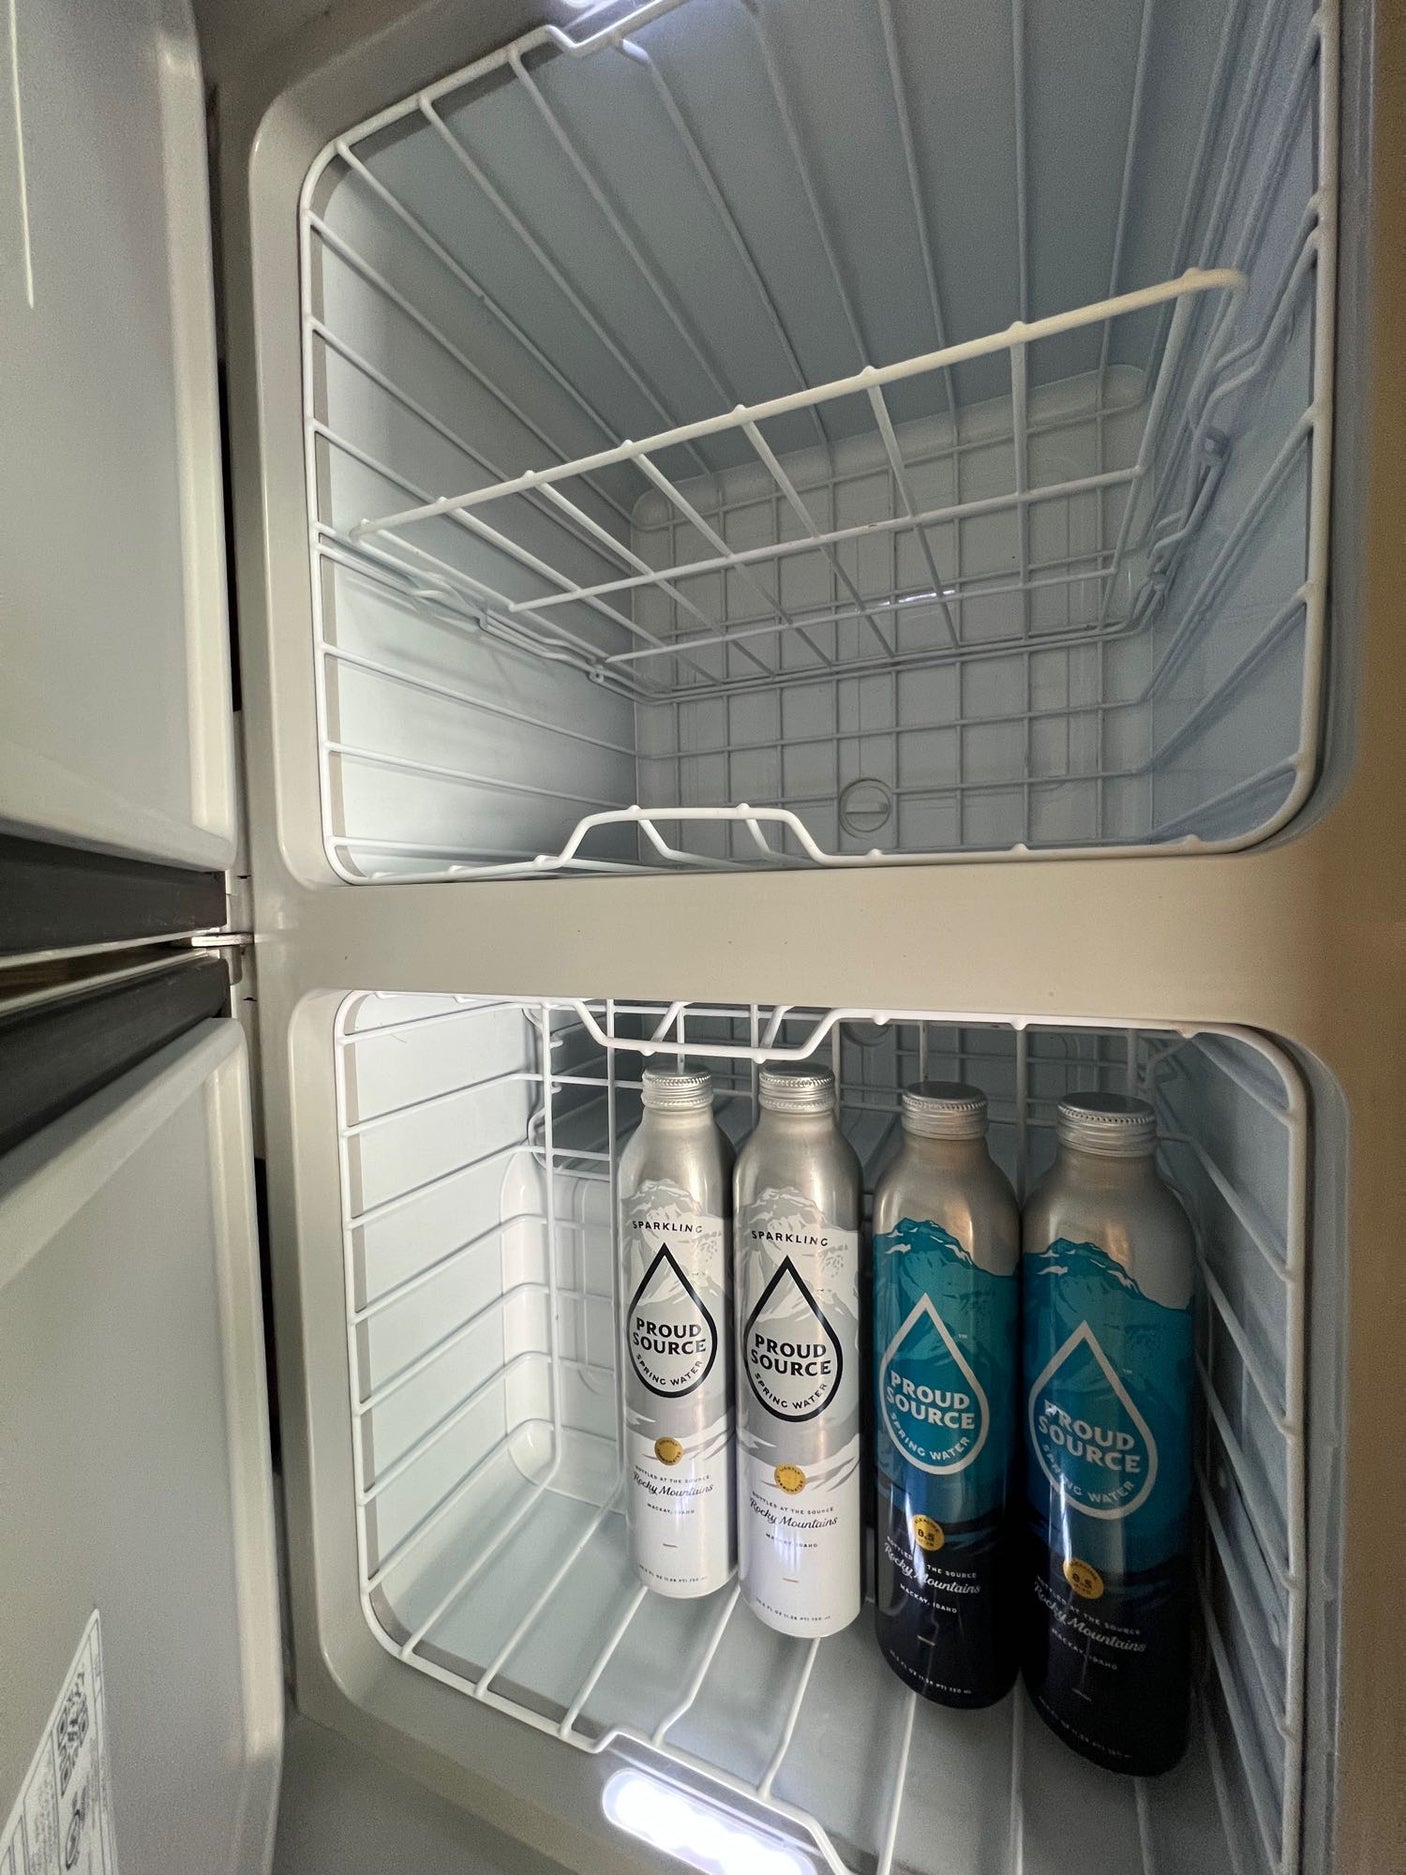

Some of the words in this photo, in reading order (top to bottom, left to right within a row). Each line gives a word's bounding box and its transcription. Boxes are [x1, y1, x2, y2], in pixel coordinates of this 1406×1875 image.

[632, 1220, 703, 1233] SPARKLING
[751, 1230, 829, 1246] SPARKLING
[636, 1317, 702, 1338] PROUD
[633, 1332, 706, 1355] SOURCE
[755, 1333, 827, 1359] PROUD
[636, 1353, 666, 1386] SPRING
[670, 1360, 703, 1386] WATER
[751, 1349, 831, 1377] SOURCE
[754, 1372, 788, 1408] SPRING
[792, 1382, 828, 1409] WATER
[891, 1370, 970, 1410] PROUD
[886, 1386, 975, 1430] SOURCE
[890, 1412, 926, 1456] SPRING
[929, 1436, 970, 1461] WATER
[1044, 1399, 1135, 1451] PROUD
[1038, 1415, 1140, 1473] SOURCE
[633, 1471, 658, 1496] Rocky
[659, 1484, 714, 1497] Mountains
[1087, 1481, 1135, 1503] WATER
[750, 1497, 777, 1524] Rocky
[778, 1516, 838, 1529] Mountains
[884, 1542, 913, 1579] Rocky
[927, 1564, 942, 1574] THE
[945, 1570, 977, 1579] SOURCE
[932, 1602, 958, 1613] IDAHO
[1034, 1580, 1067, 1625] Rocky
[1067, 1618, 1147, 1652] Mountains
